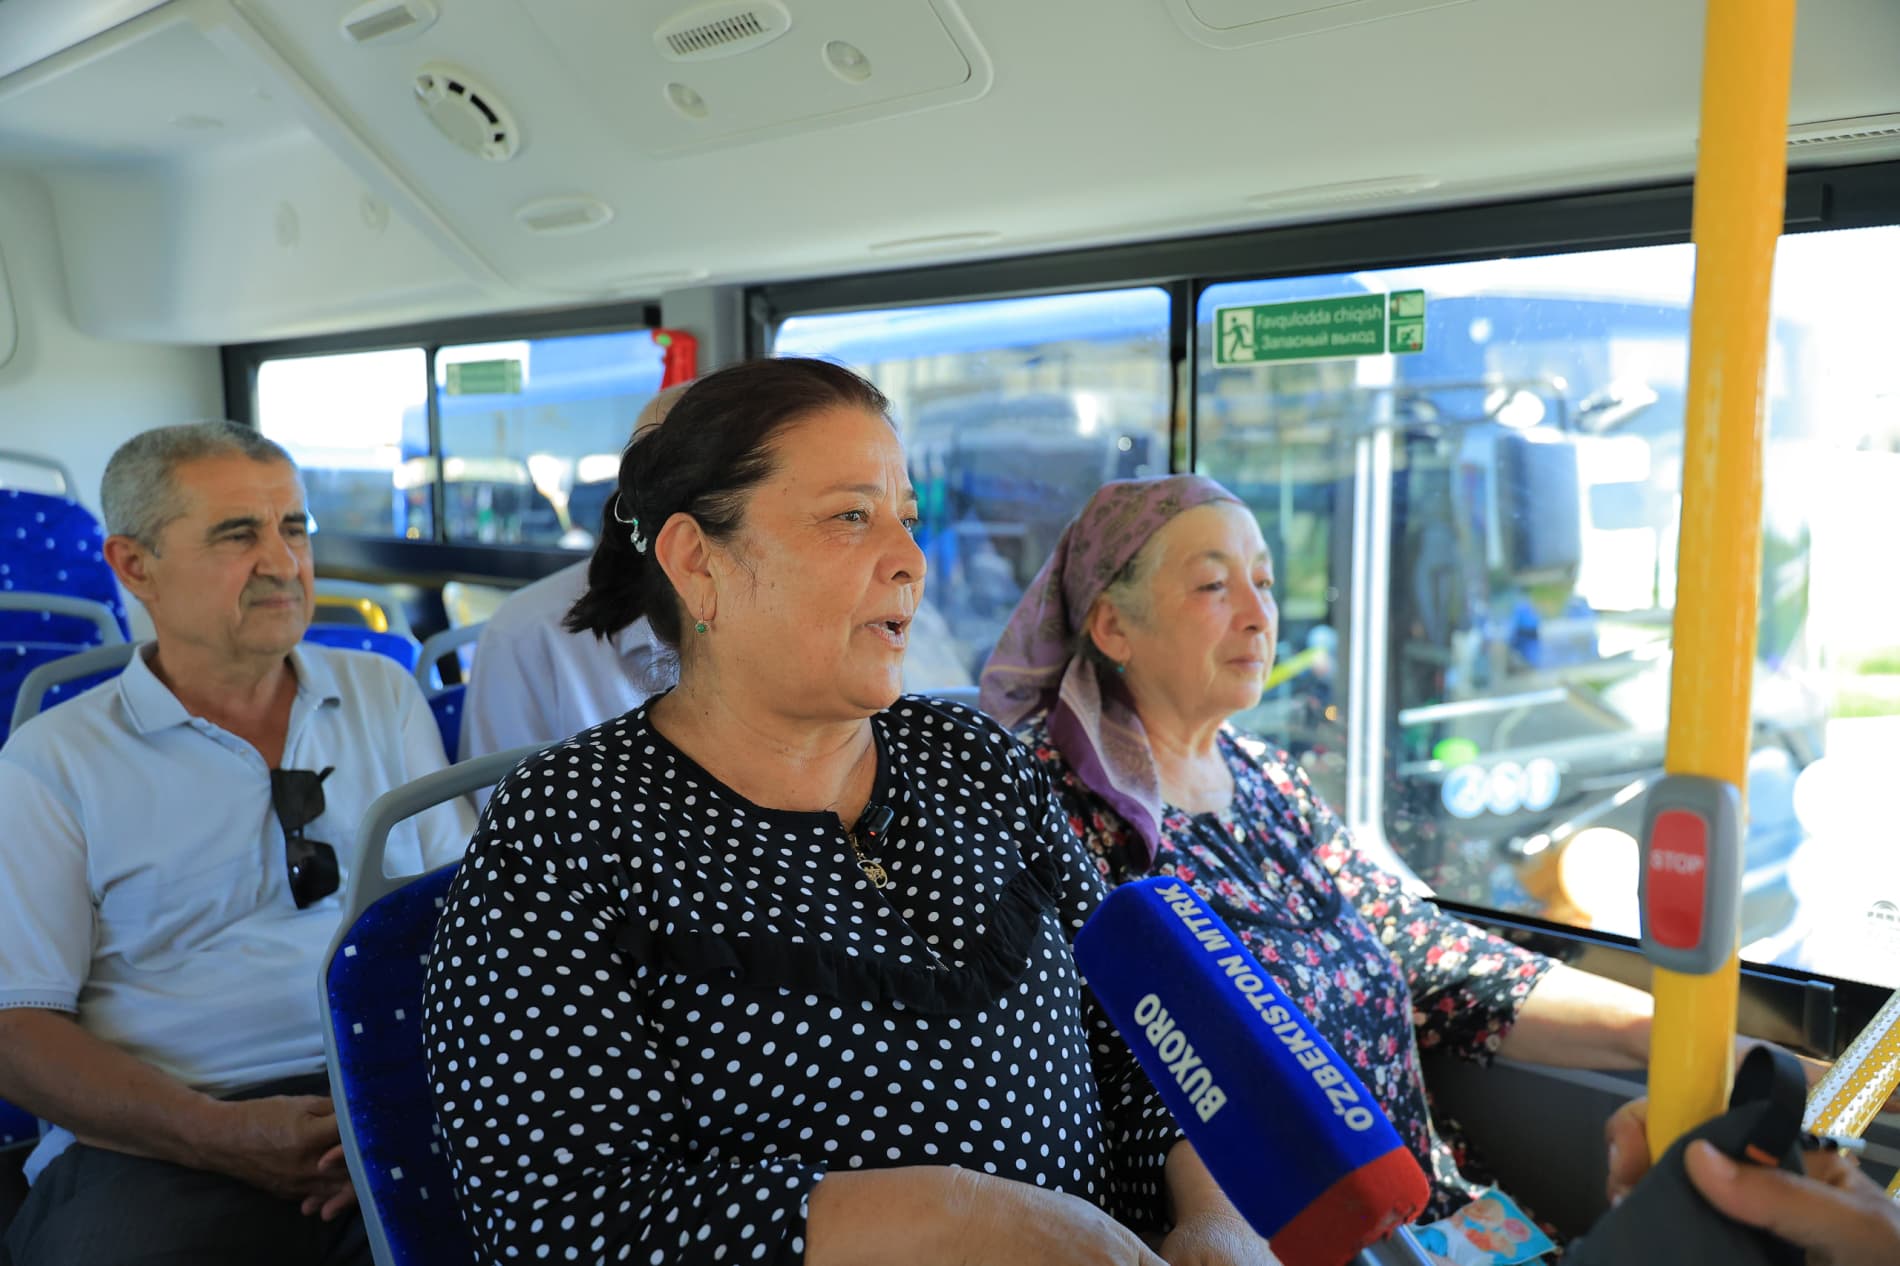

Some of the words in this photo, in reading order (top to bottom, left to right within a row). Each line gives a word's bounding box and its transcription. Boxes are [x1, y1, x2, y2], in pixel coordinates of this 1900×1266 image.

[1333, 304, 1382, 324] chiqish
[1331, 330, 1376, 346] выход
[1649, 848, 1704, 875] STOP
[1153, 882, 1233, 953] MTRK
[1134, 993, 1228, 1123] BUXORO
